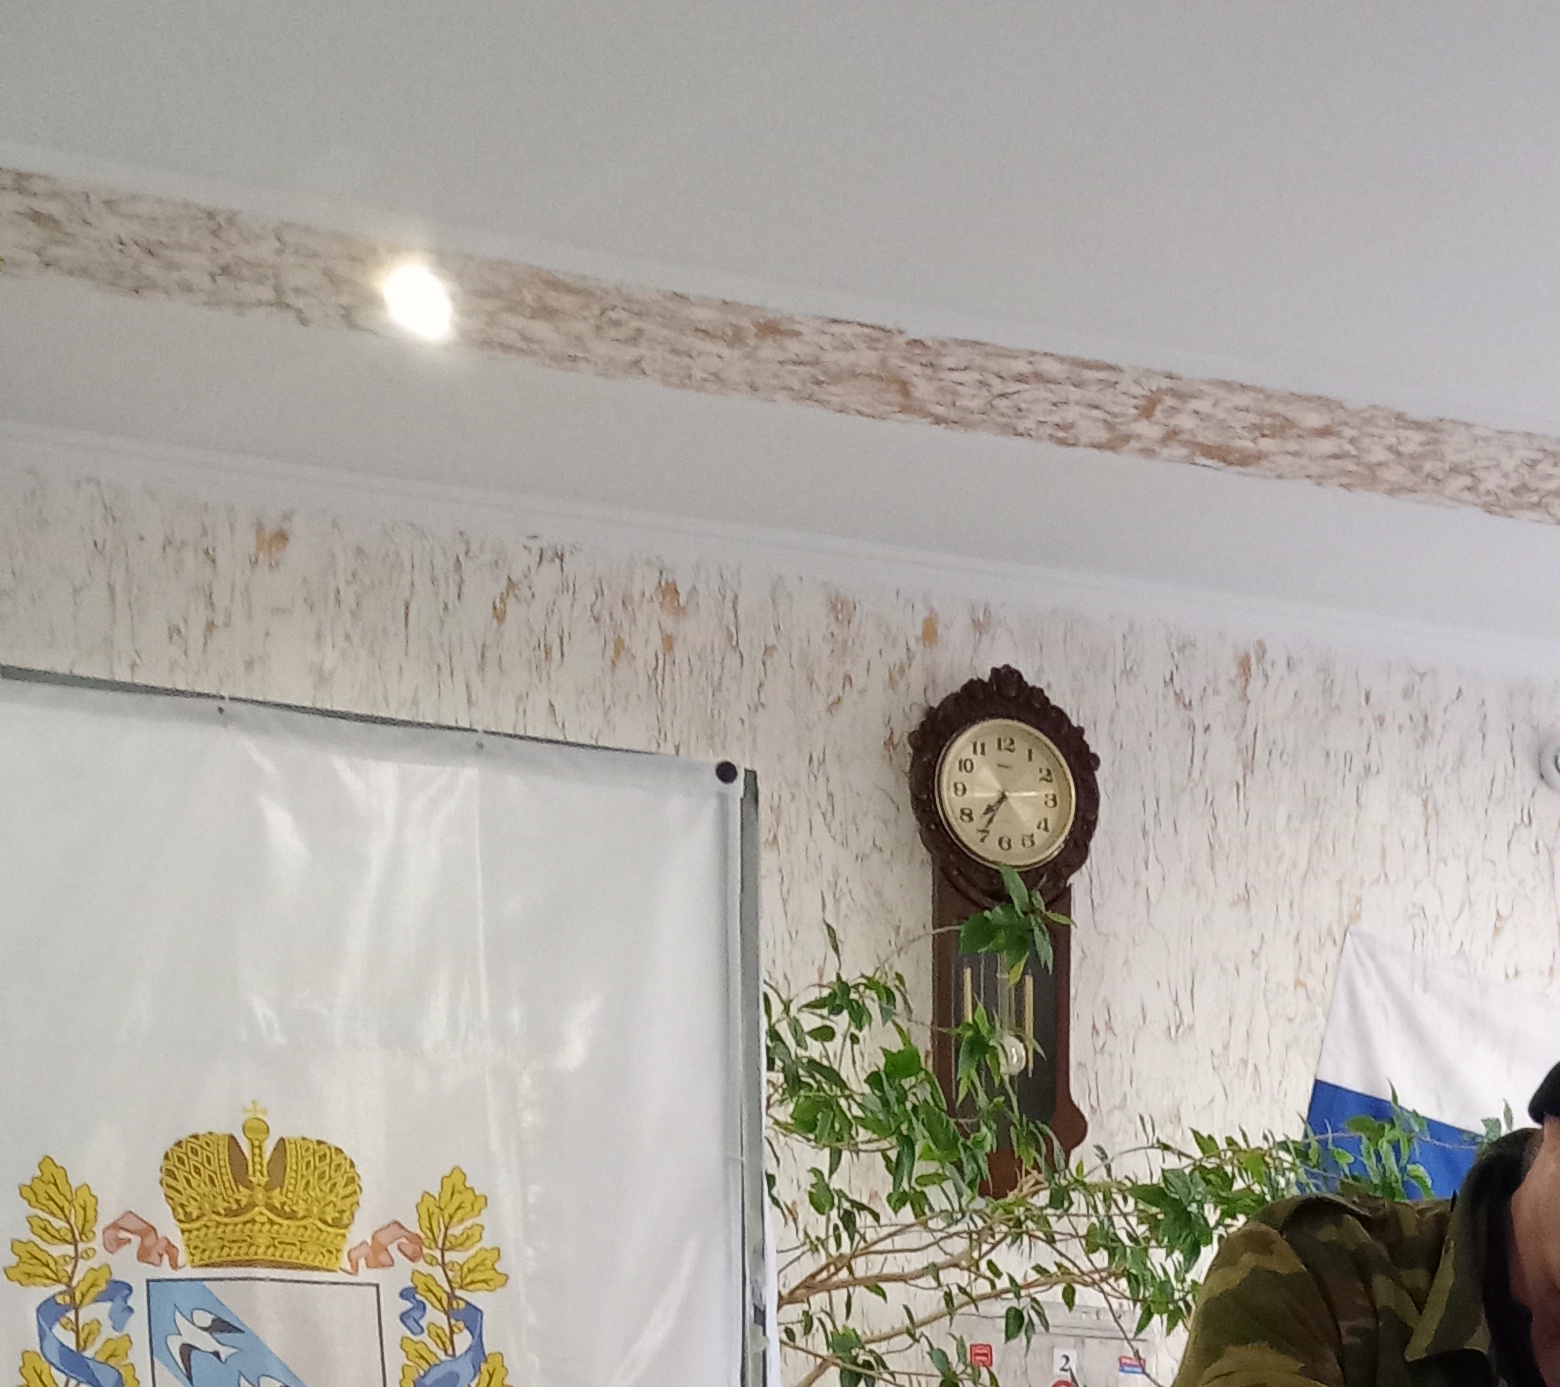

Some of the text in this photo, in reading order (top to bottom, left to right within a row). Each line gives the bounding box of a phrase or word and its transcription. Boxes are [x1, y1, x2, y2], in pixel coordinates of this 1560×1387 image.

[972, 741, 985, 756] 11
[997, 737, 1015, 753] 12
[1027, 748, 1033, 762] 1
[958, 758, 974, 773] 10
[1039, 767, 1053, 783] 2
[953, 781, 967, 797] 9
[1044, 793, 1057, 808] 3
[960, 807, 974, 823] 8
[1036, 817, 1049, 832] 4
[976, 828, 990, 843] 7
[1021, 832, 1035, 848] 5
[997, 836, 1012, 851] 6
[1059, 1354, 1071, 1372] 2
